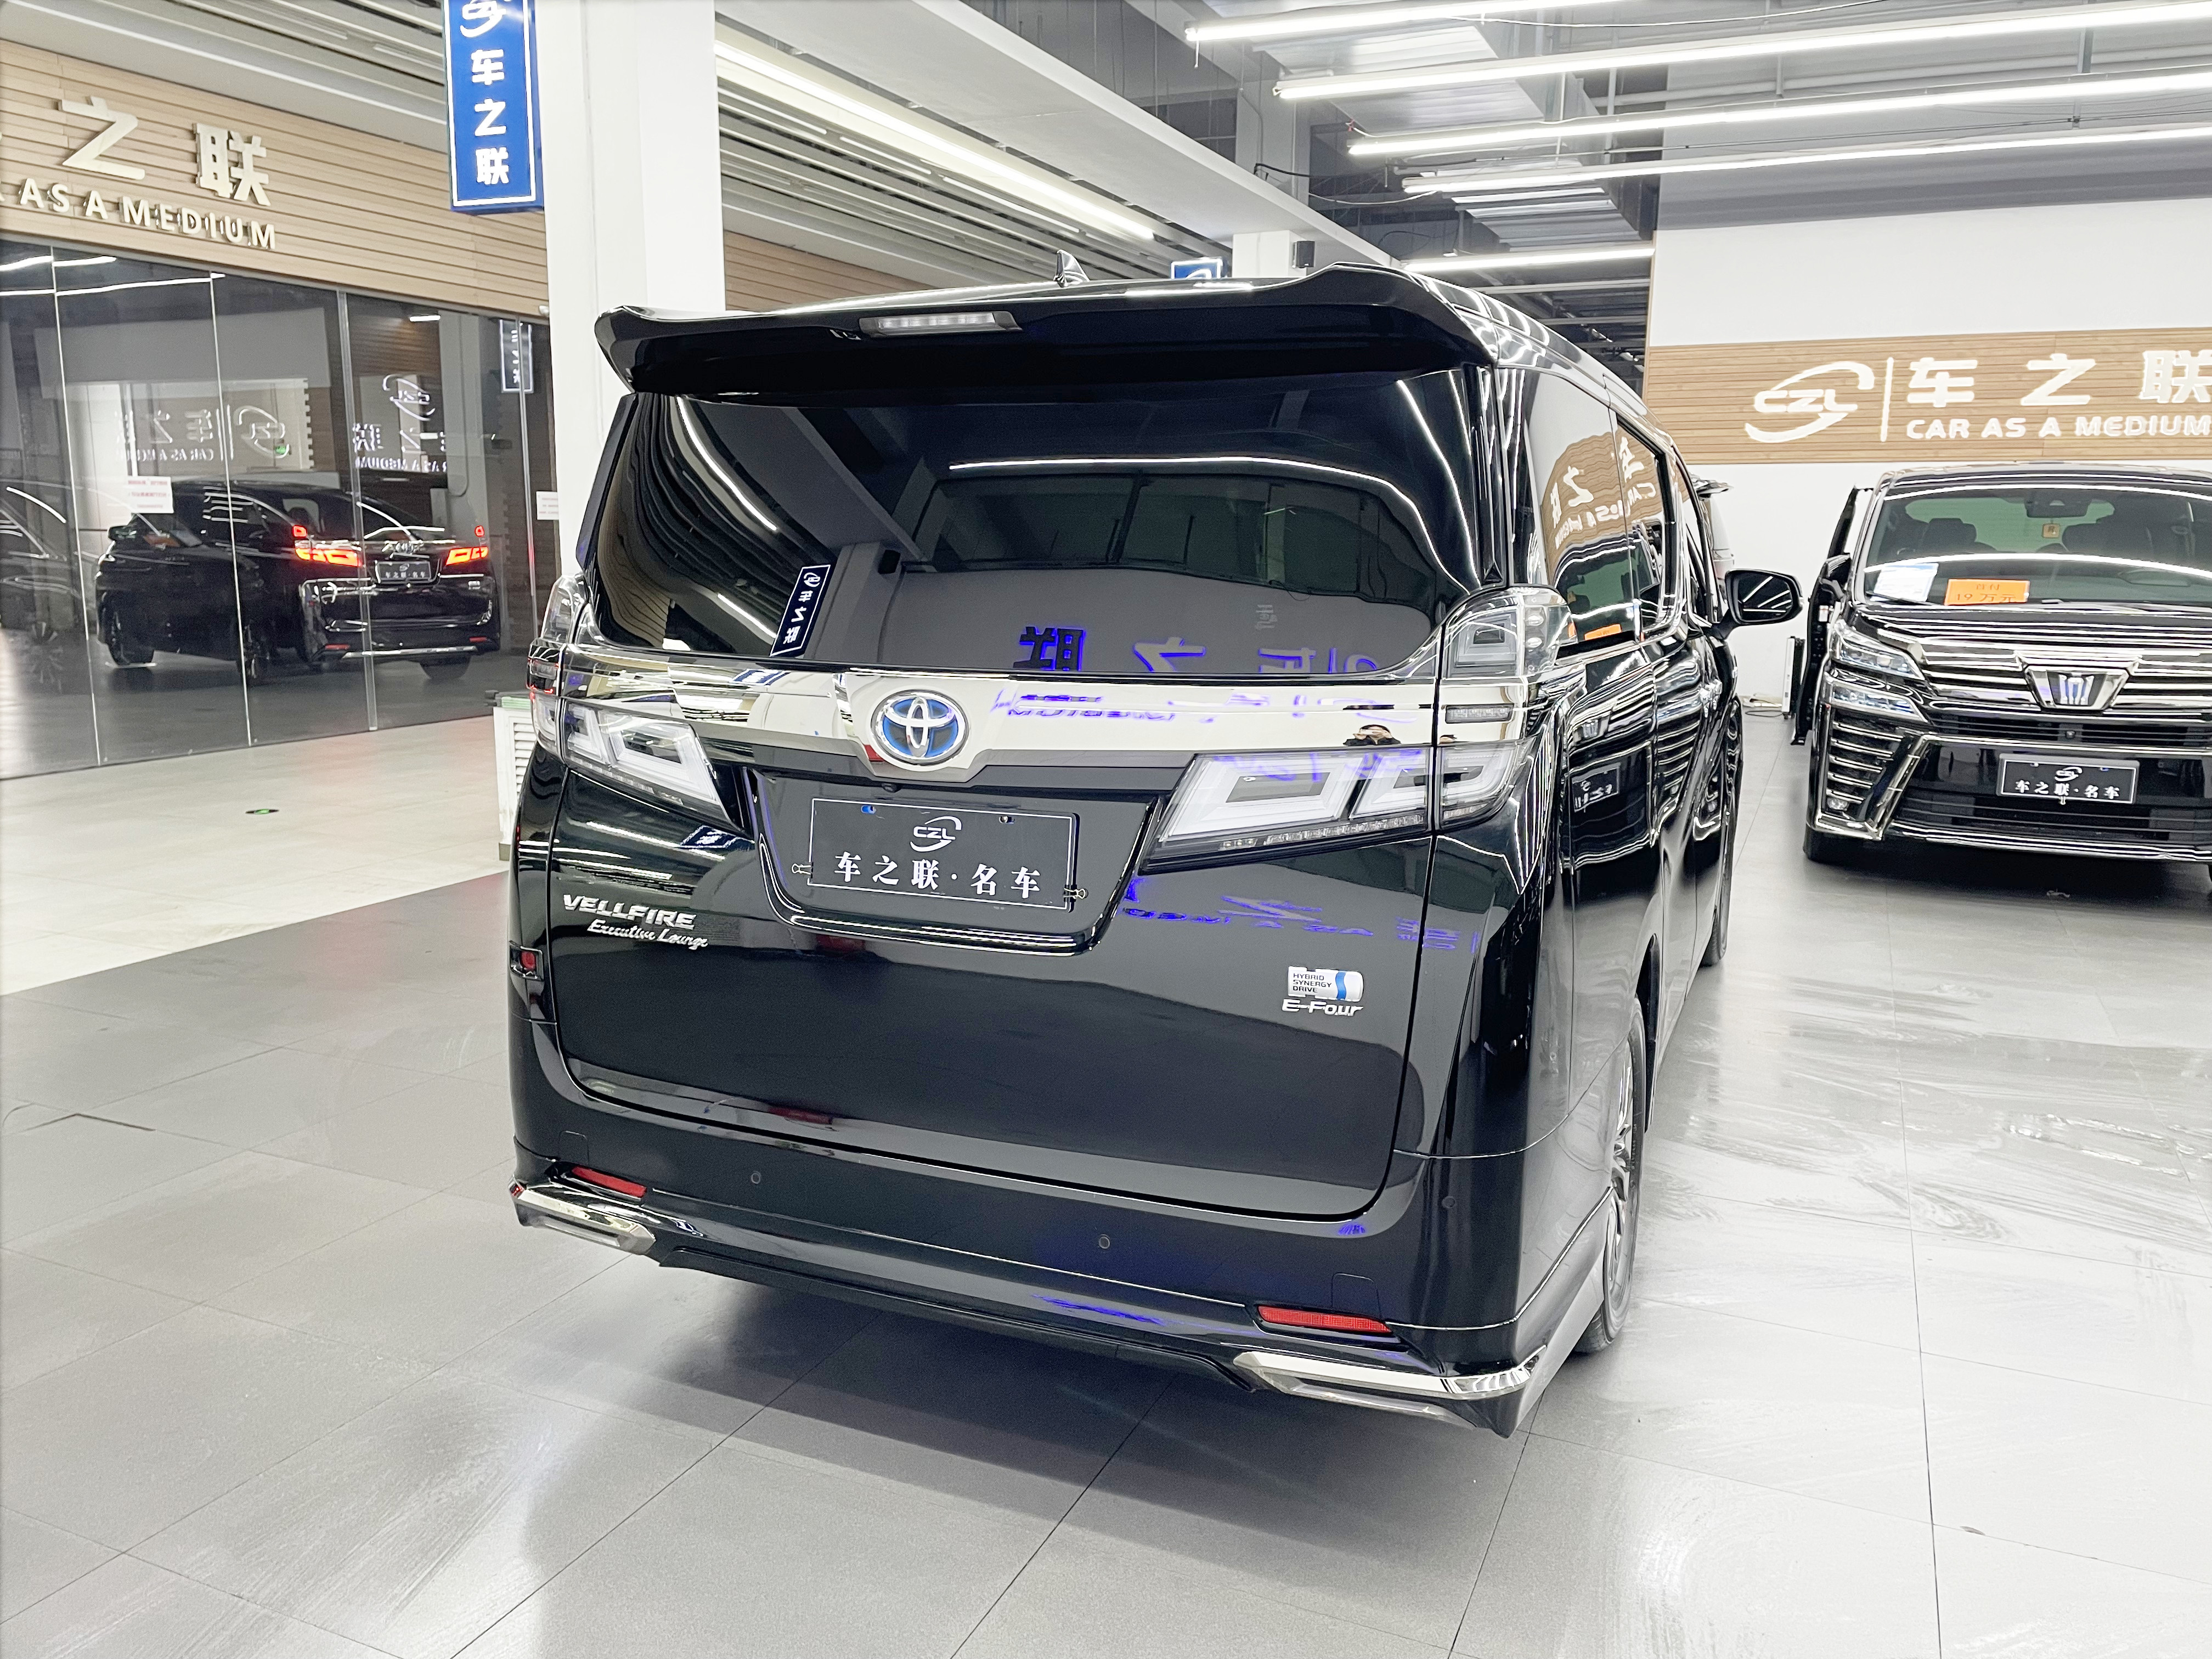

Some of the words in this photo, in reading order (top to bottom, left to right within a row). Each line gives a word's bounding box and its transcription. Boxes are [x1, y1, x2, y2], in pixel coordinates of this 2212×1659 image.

[471, 49, 509, 185] 车之联
[0, 95, 272, 206] 之联
[19, 178, 71, 213] AS
[84, 190, 109, 219] A
[120, 196, 275, 250] MEDIUM
[1907, 350, 2212, 408] 车之联
[1754, 388, 1858, 413] CZL
[1906, 419, 1970, 439] CAR
[1981, 417, 2027, 438] AS
[2038, 417, 2062, 438] A
[2075, 415, 2212, 437] MEDIUM
[913, 825, 956, 840] CZL
[834, 851, 1041, 899] 车之联·名车
[563, 894, 697, 930] VELLFIRE
[586, 918, 656, 941] Executive
[657, 928, 709, 950] Lounge
[1293, 973, 1325, 981] HYBRID
[1293, 980, 1332, 988] SYNERGY
[1282, 998, 1364, 1017] E-Four
